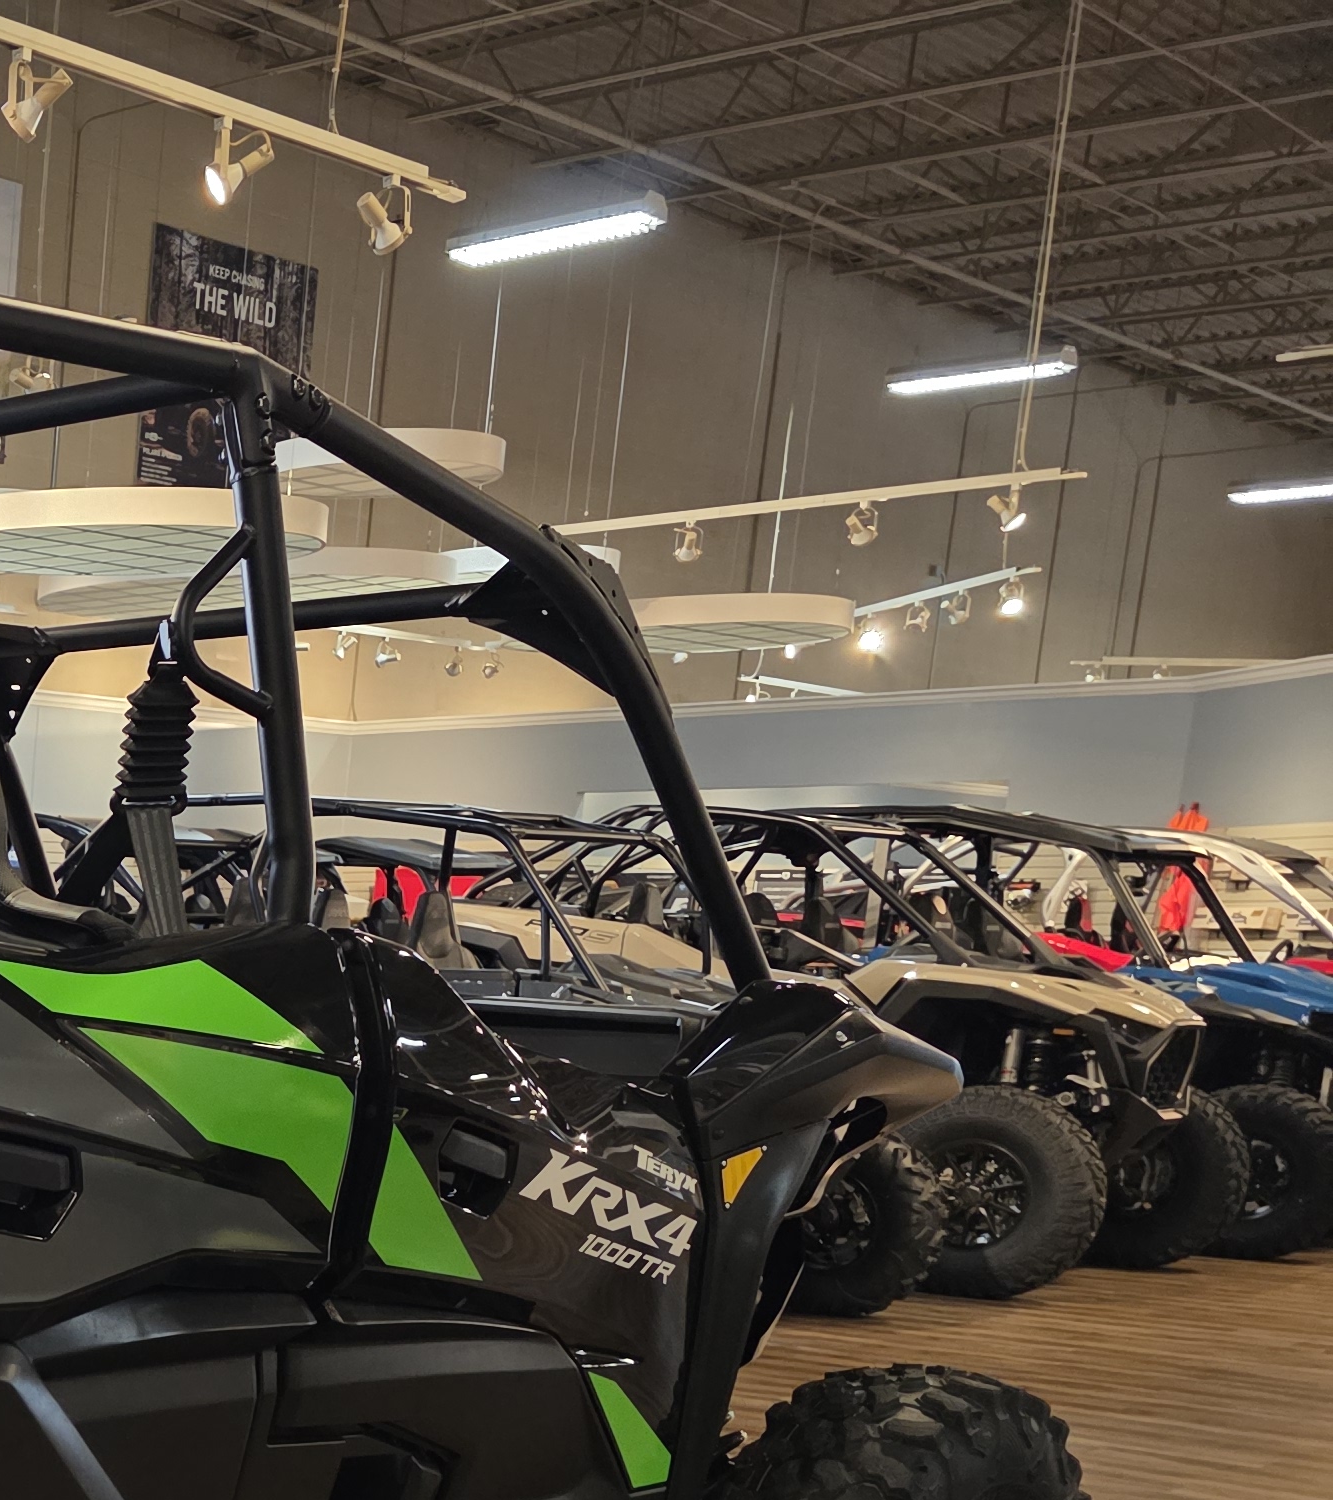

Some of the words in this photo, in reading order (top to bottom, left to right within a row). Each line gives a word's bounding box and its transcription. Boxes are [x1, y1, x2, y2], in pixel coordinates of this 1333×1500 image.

[209, 264, 231, 280] KEEP
[231, 270, 265, 291] CHASING
[193, 281, 229, 317] THE
[233, 292, 277, 328] WILD
[518, 1148, 698, 1258] KRX4
